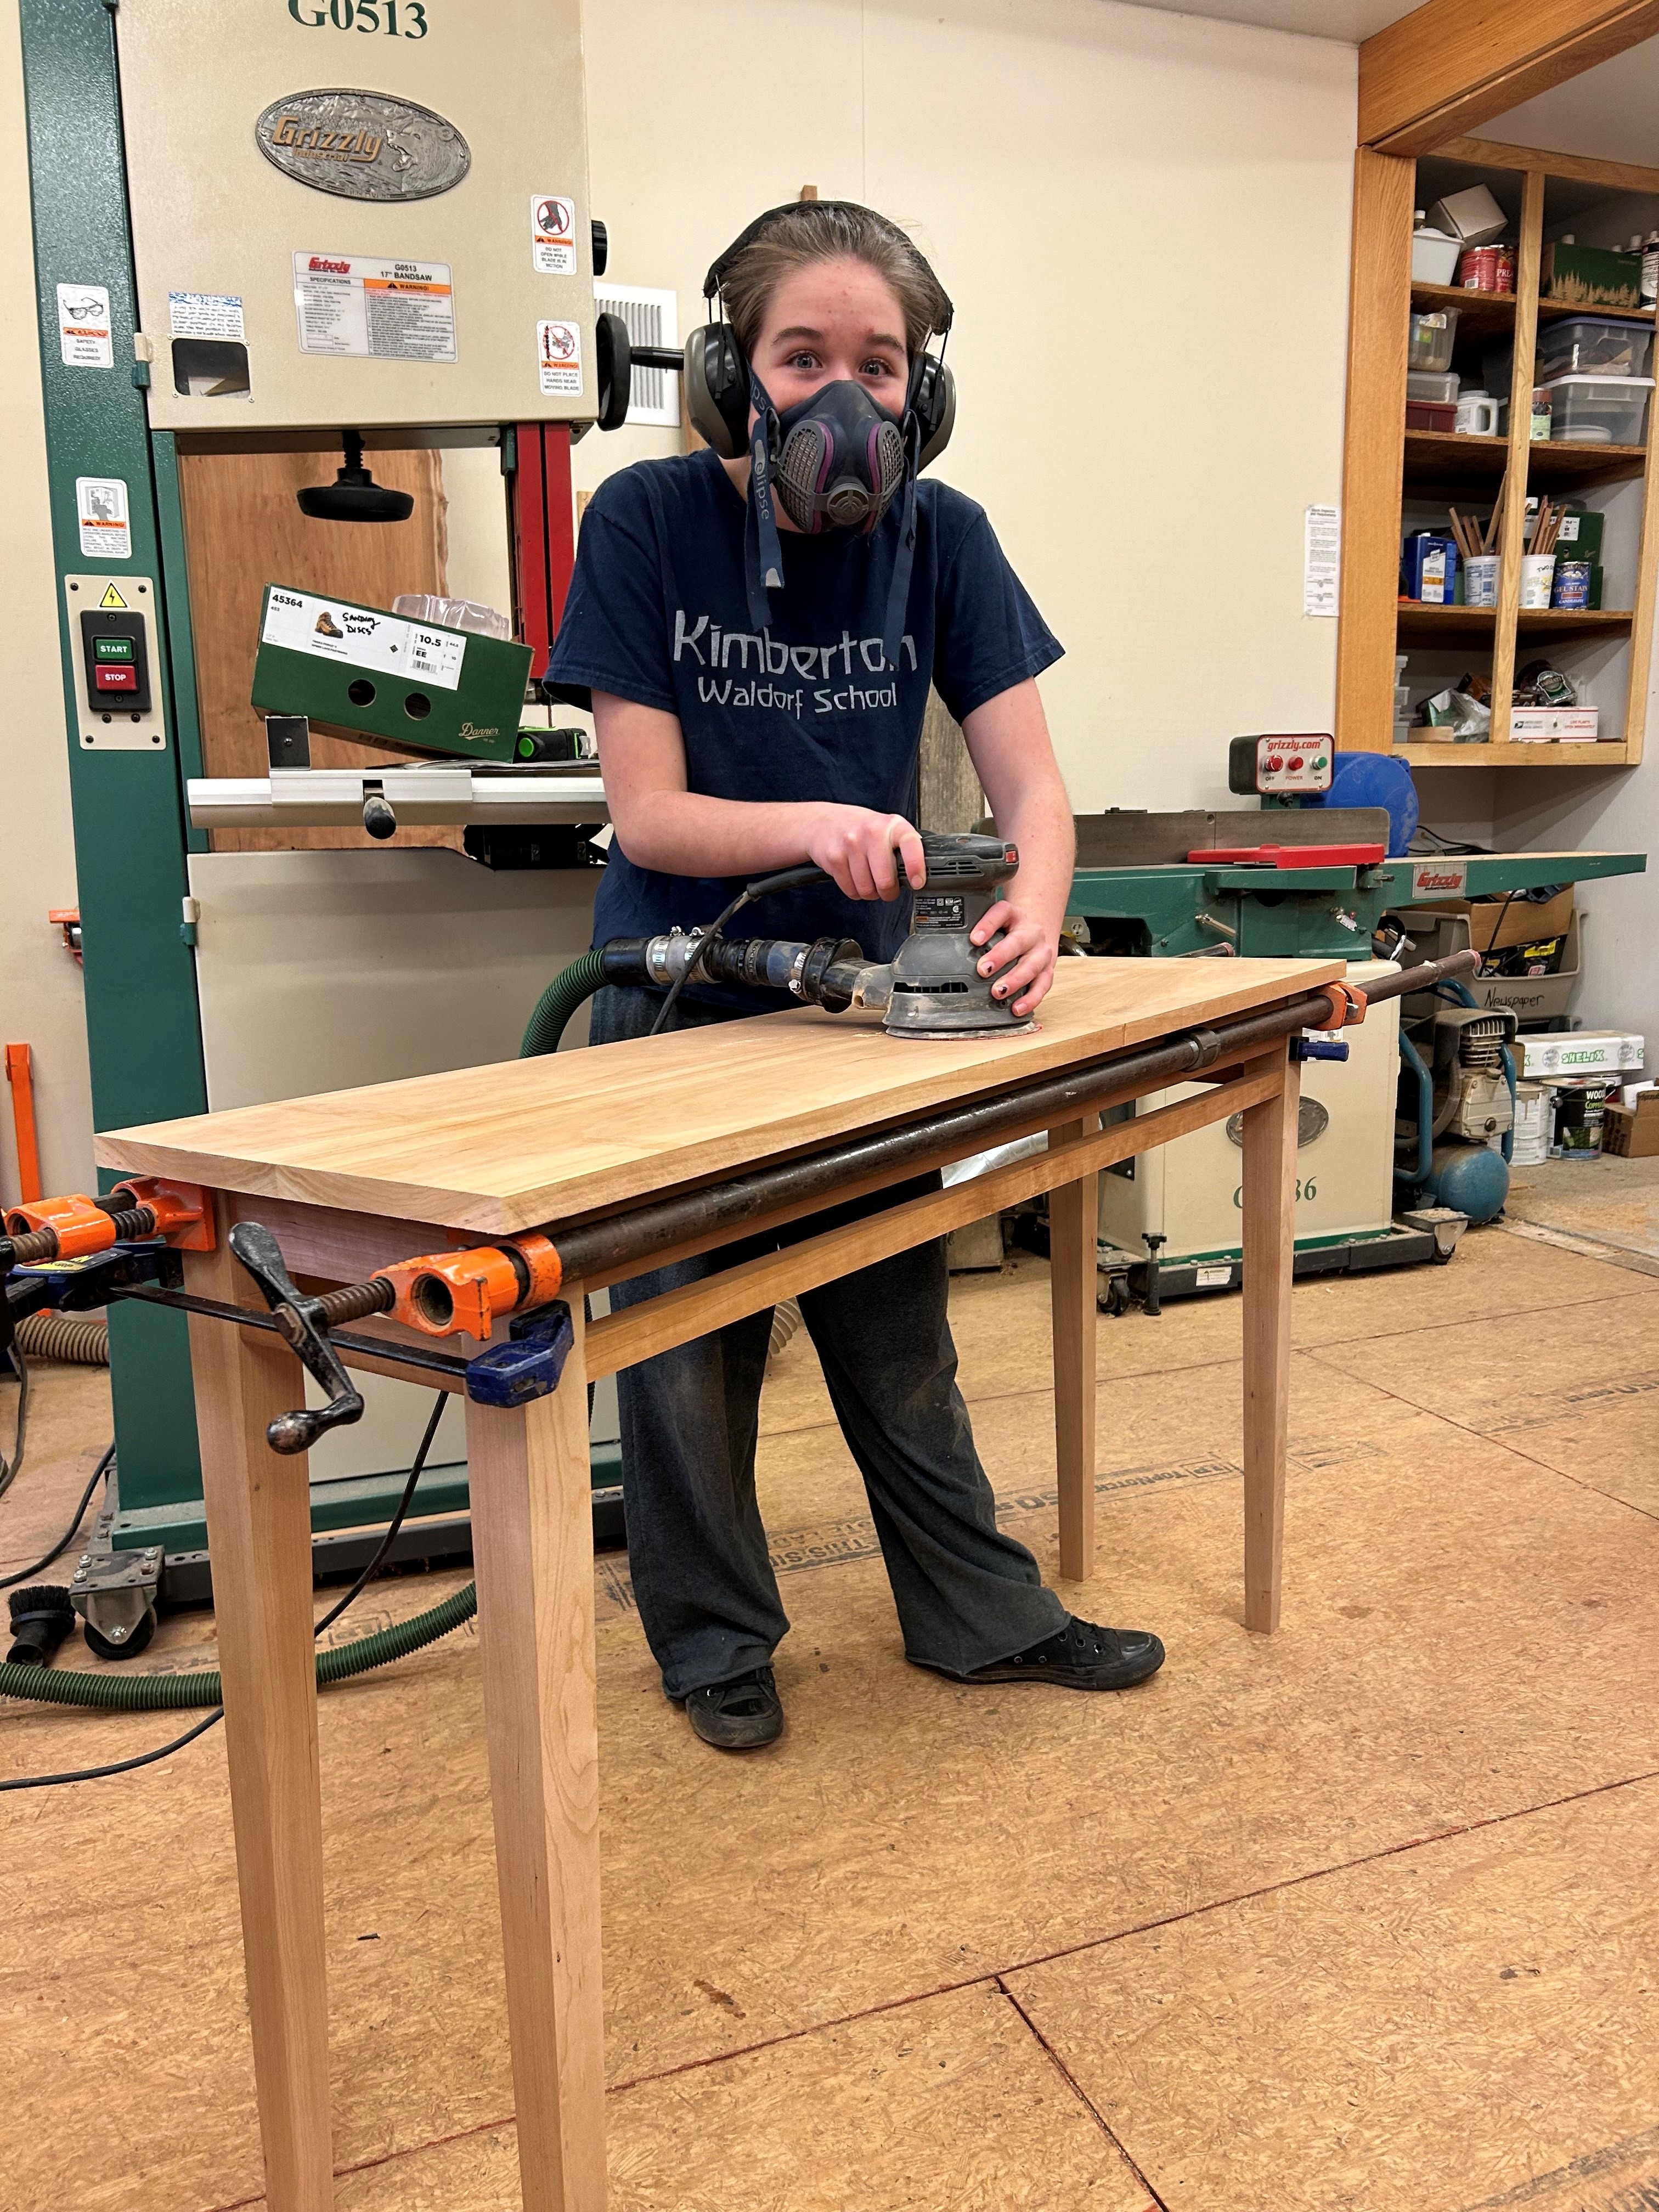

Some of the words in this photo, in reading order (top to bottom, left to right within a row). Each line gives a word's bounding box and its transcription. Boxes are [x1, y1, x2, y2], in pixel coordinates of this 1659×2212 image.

[288, 0, 428, 39] G0513
[274, 115, 382, 162] Grizzly
[309, 257, 351, 274] Grizzly
[394, 264, 417, 272] G0513
[310, 276, 351, 285] SPECIFICATIONS
[394, 272, 432, 281] BANDSAW
[754, 462, 770, 520] elipse
[272, 594, 303, 608] 45364
[419, 634, 442, 647] 10.5
[415, 650, 427, 658] EE
[698, 676, 803, 720] Waldorf
[814, 682, 897, 713] School
[459, 722, 500, 739] Danner
[1267, 739, 1321, 752] grizzly.com
[1417, 871, 1463, 890] Grizzly
[1485, 986, 1545, 1009] Newspaper
[1561, 1049, 1605, 1065] SHELIX
[809, 1539, 871, 1558] THIS
